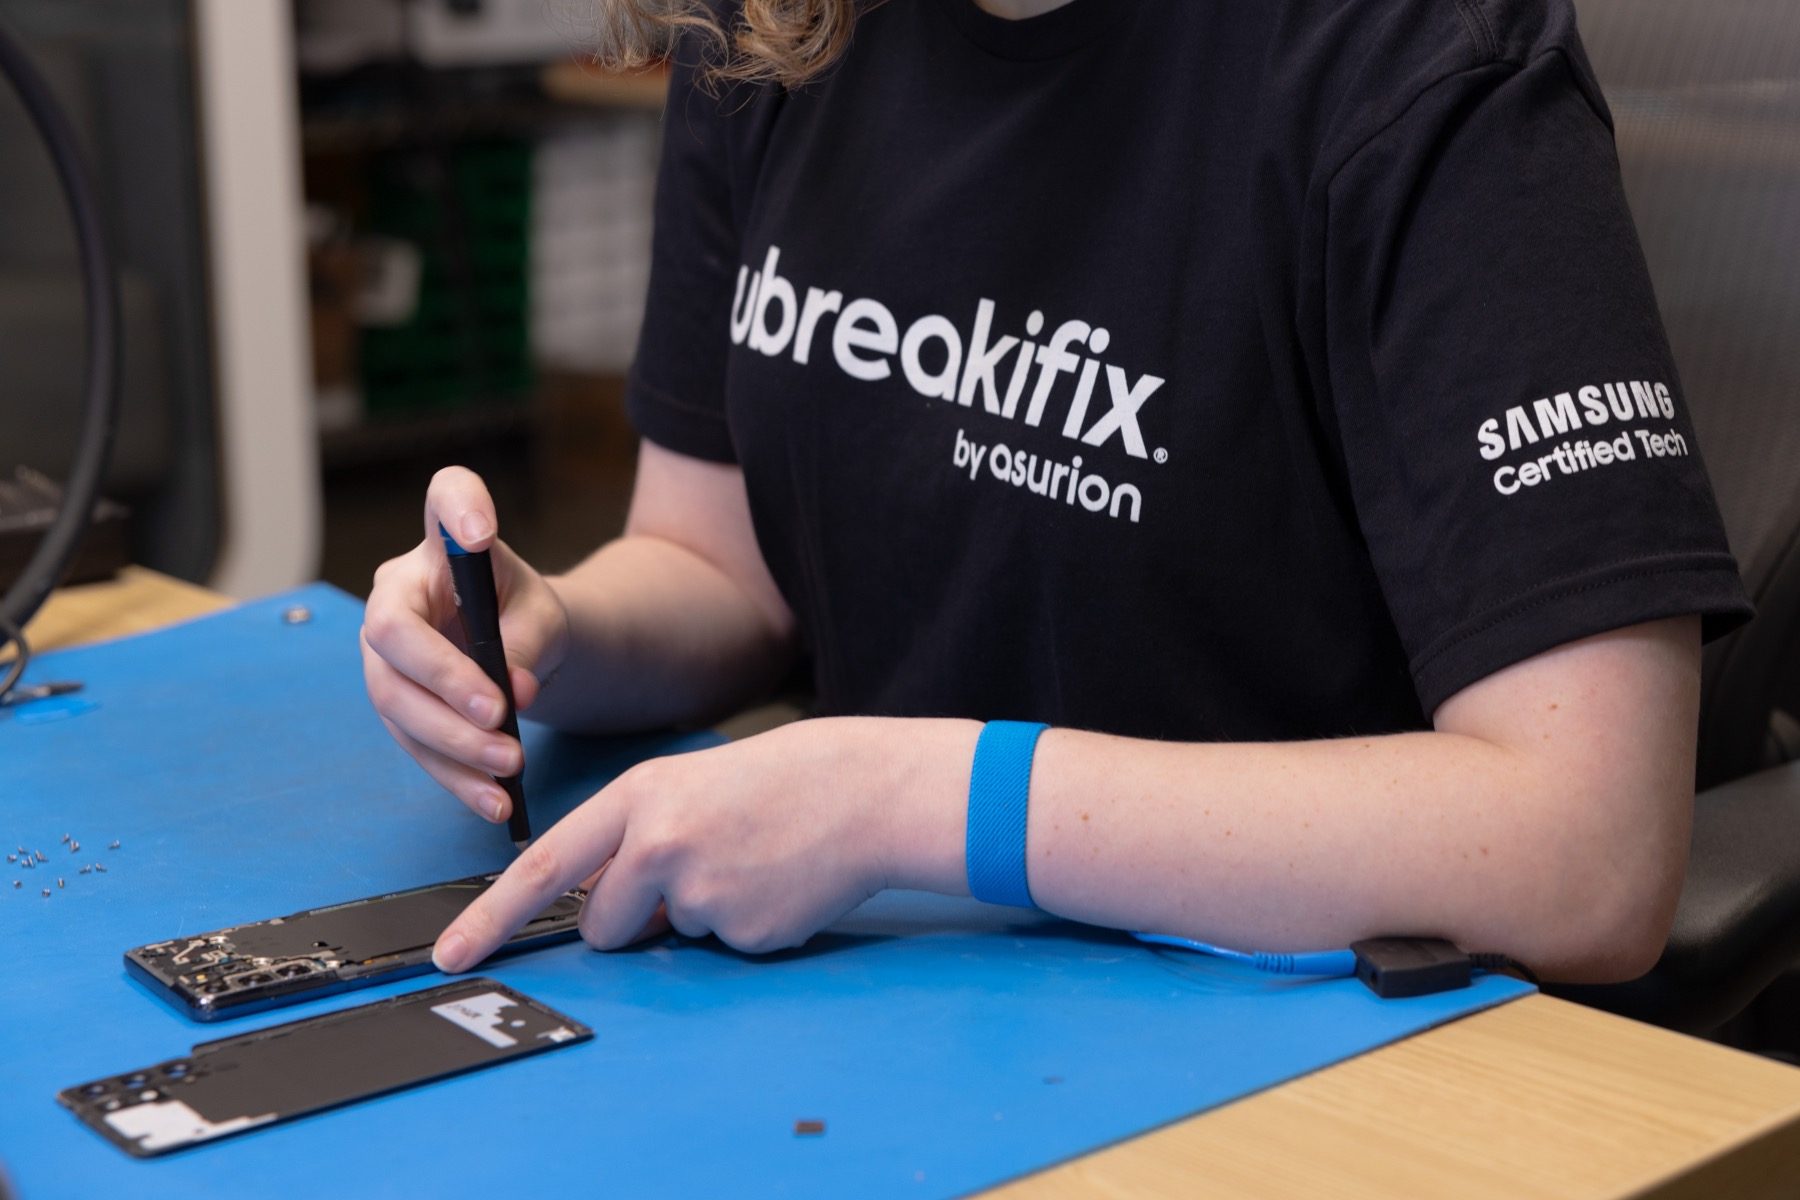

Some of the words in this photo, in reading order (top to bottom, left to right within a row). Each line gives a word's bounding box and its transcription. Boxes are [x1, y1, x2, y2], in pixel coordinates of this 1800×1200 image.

[1477, 380, 1675, 461] SAMSUNG
[953, 429, 987, 480] by
[989, 444, 1142, 523] asurion
[1493, 431, 1636, 495] Certified
[1634, 428, 1689, 458] Tech
